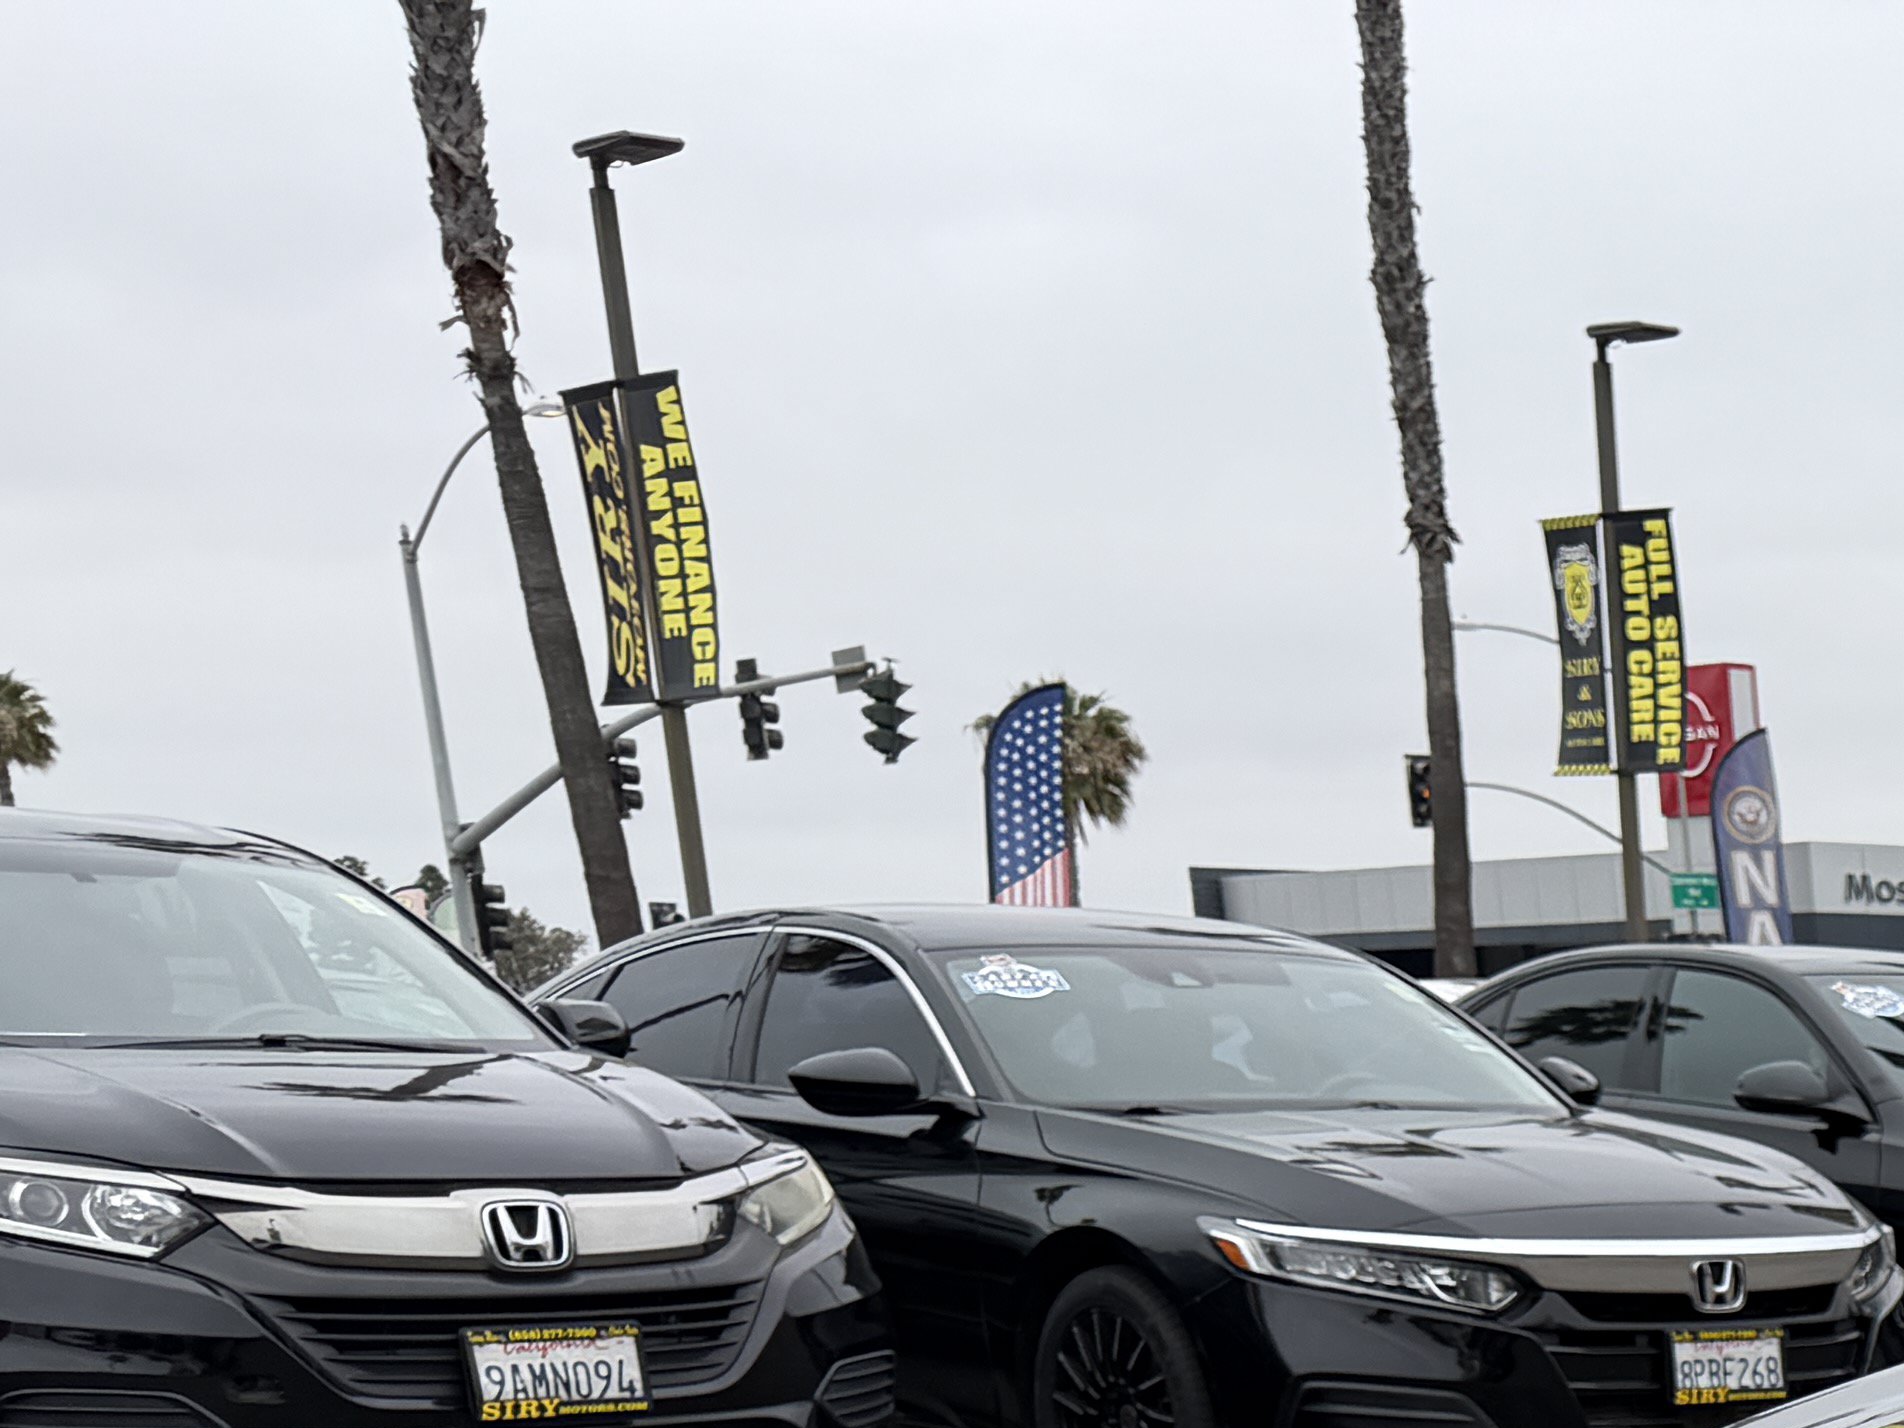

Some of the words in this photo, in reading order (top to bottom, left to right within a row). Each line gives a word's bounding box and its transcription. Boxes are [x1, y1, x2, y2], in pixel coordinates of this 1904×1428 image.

[655, 385, 693, 470] WE
[572, 403, 637, 689] SIRY
[639, 443, 689, 640] ANYONE
[672, 480, 718, 689] FINANCE
[1642, 518, 1675, 600] FULL
[1617, 543, 1653, 643] AUTO
[1626, 648, 1656, 745] CARE
[1652, 614, 1683, 766] SERVICE
[481, 1399, 560, 1422] SIRY
[484, 1358, 638, 1401] 9AMN094
[1674, 1386, 1730, 1405] SIRY
